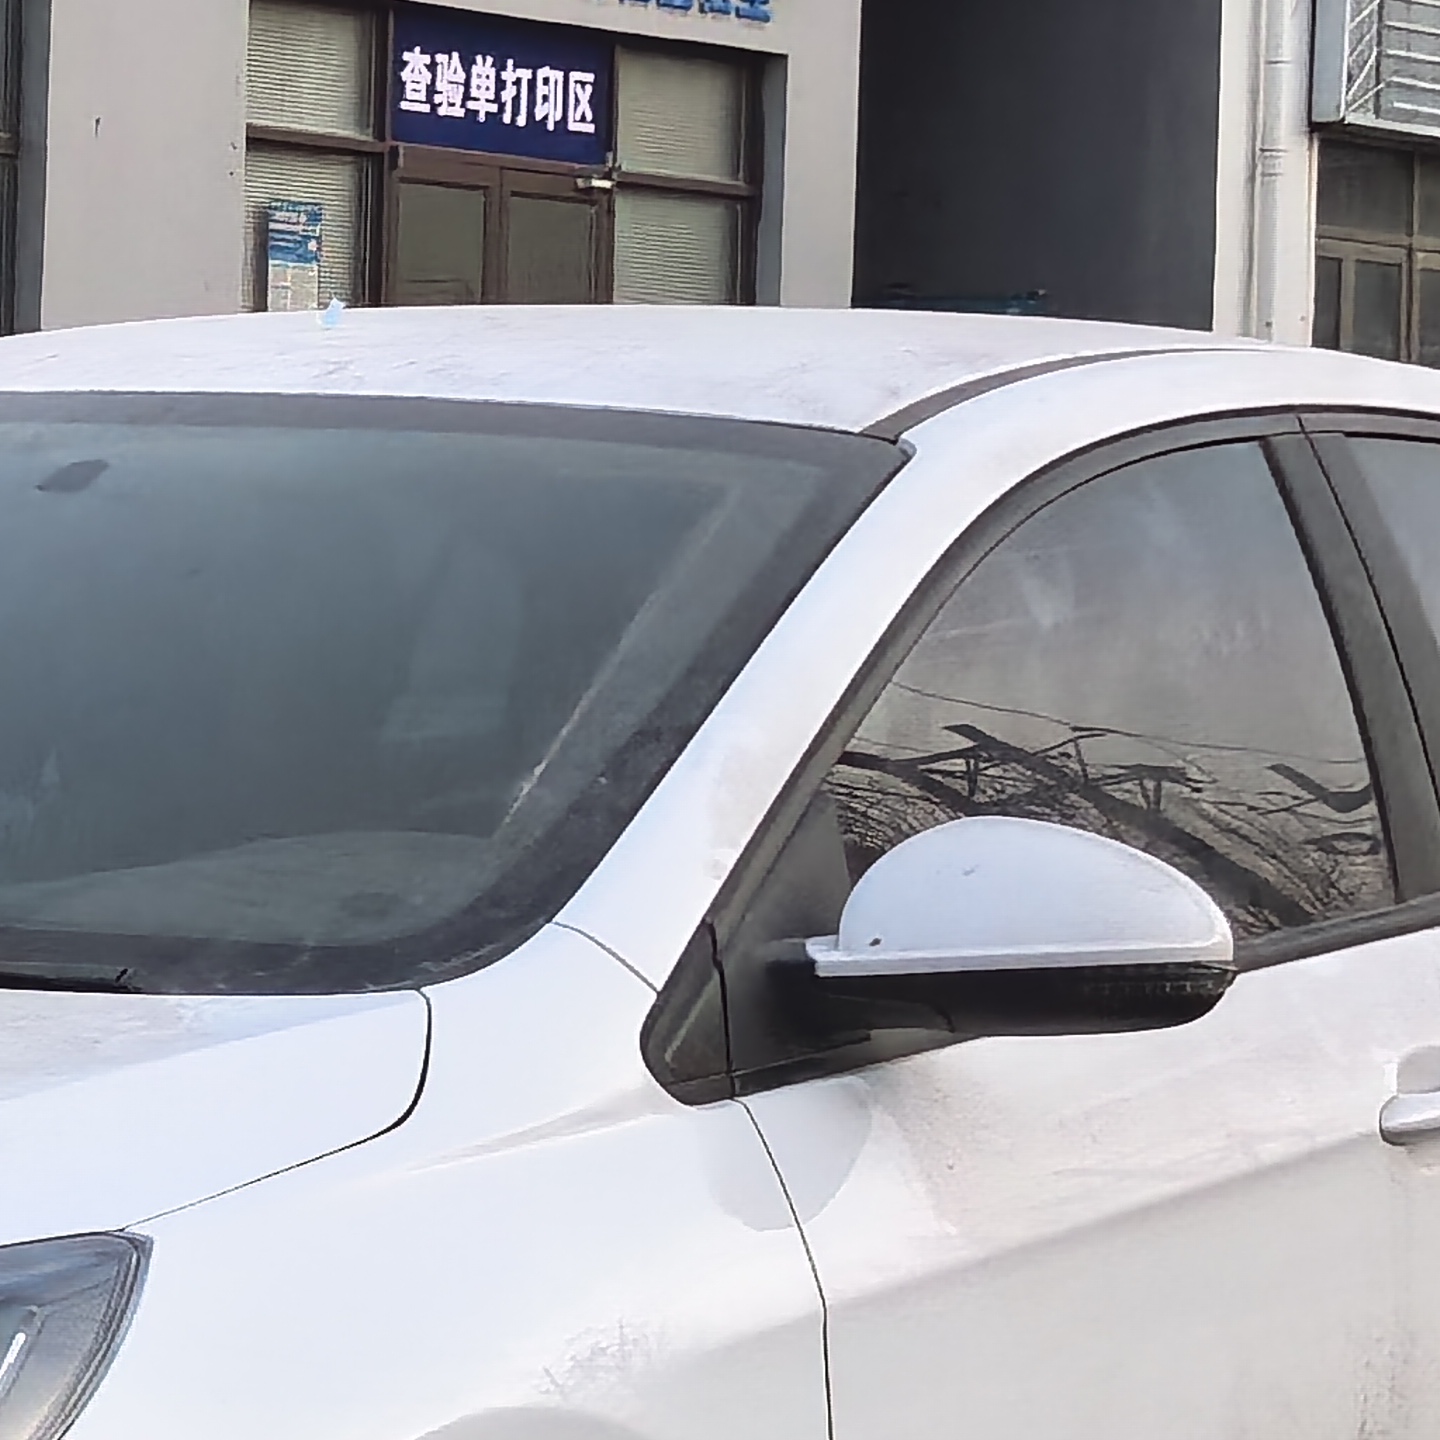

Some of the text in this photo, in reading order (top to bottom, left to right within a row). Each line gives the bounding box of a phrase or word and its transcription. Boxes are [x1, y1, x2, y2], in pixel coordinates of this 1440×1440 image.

[398, 46, 596, 134] 查验单打印区
